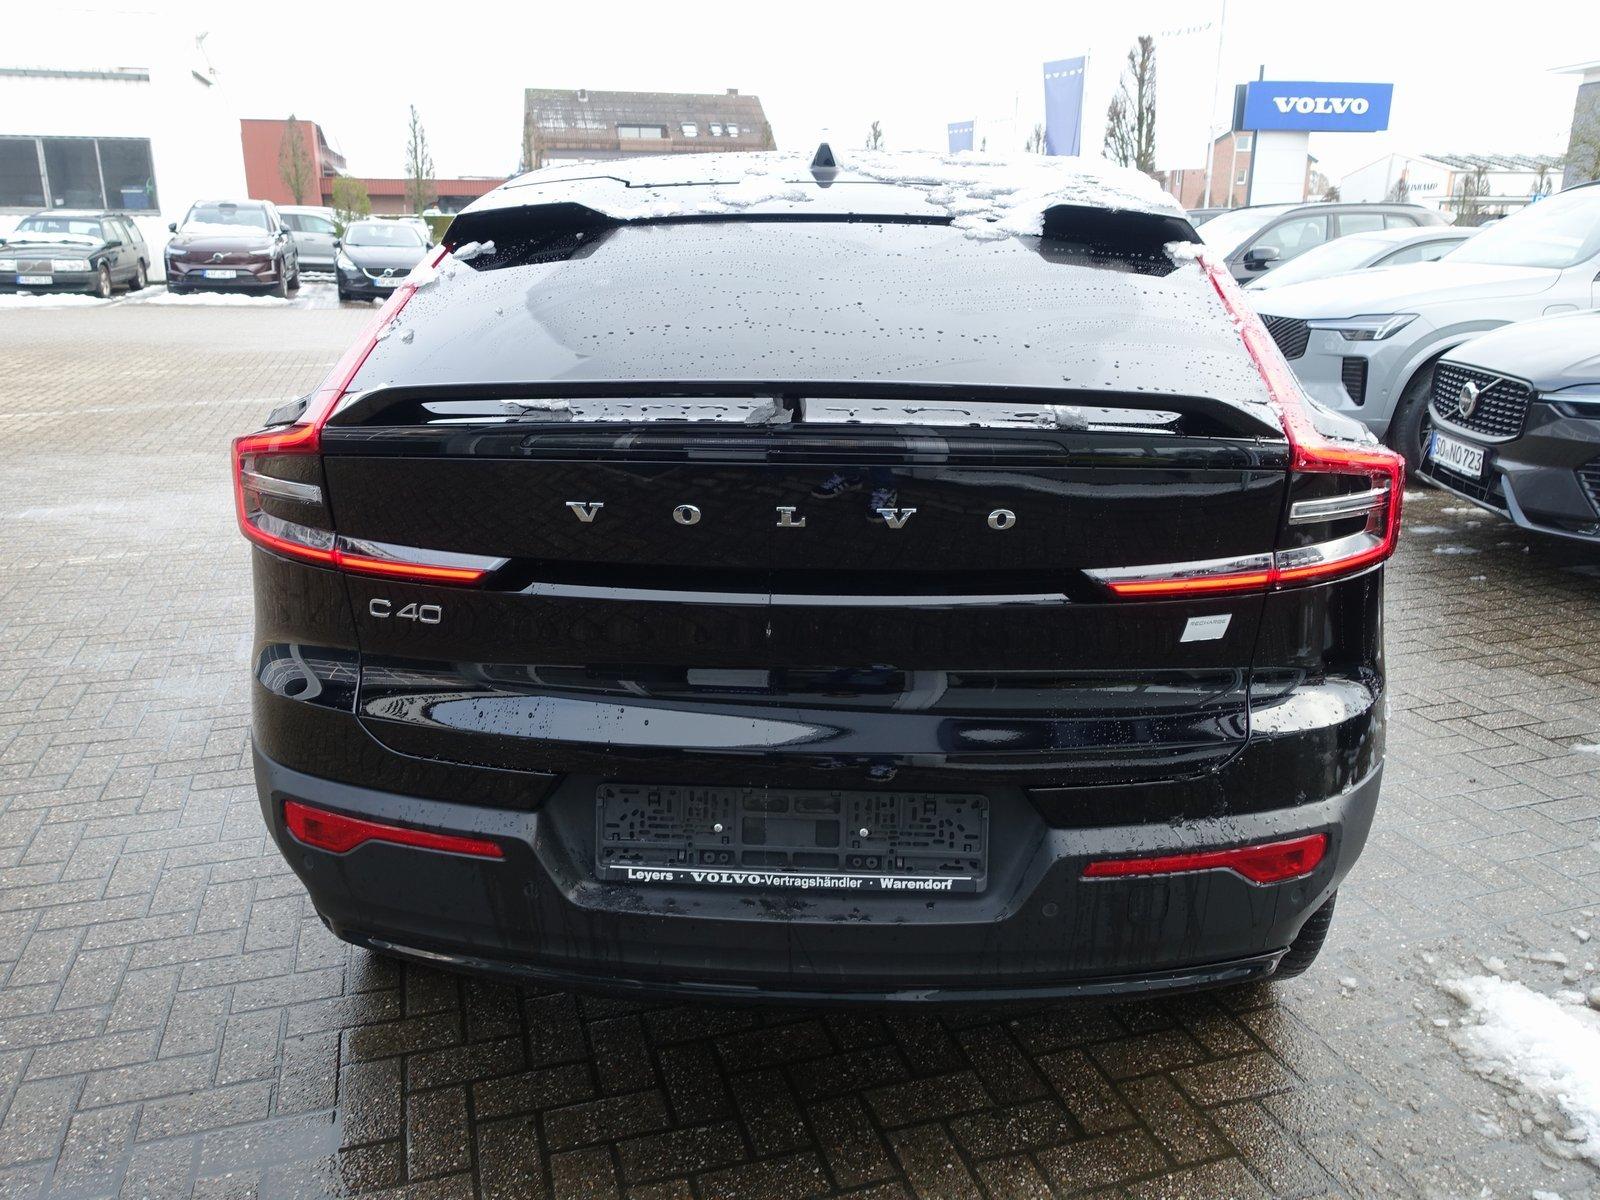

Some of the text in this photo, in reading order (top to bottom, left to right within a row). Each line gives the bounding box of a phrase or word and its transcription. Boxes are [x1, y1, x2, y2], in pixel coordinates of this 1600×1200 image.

[1272, 96, 1370, 115] VOLVO
[565, 501, 1017, 531] VOLVO
[627, 868, 674, 882] Leyers
[880, 877, 953, 890] Warendorf
